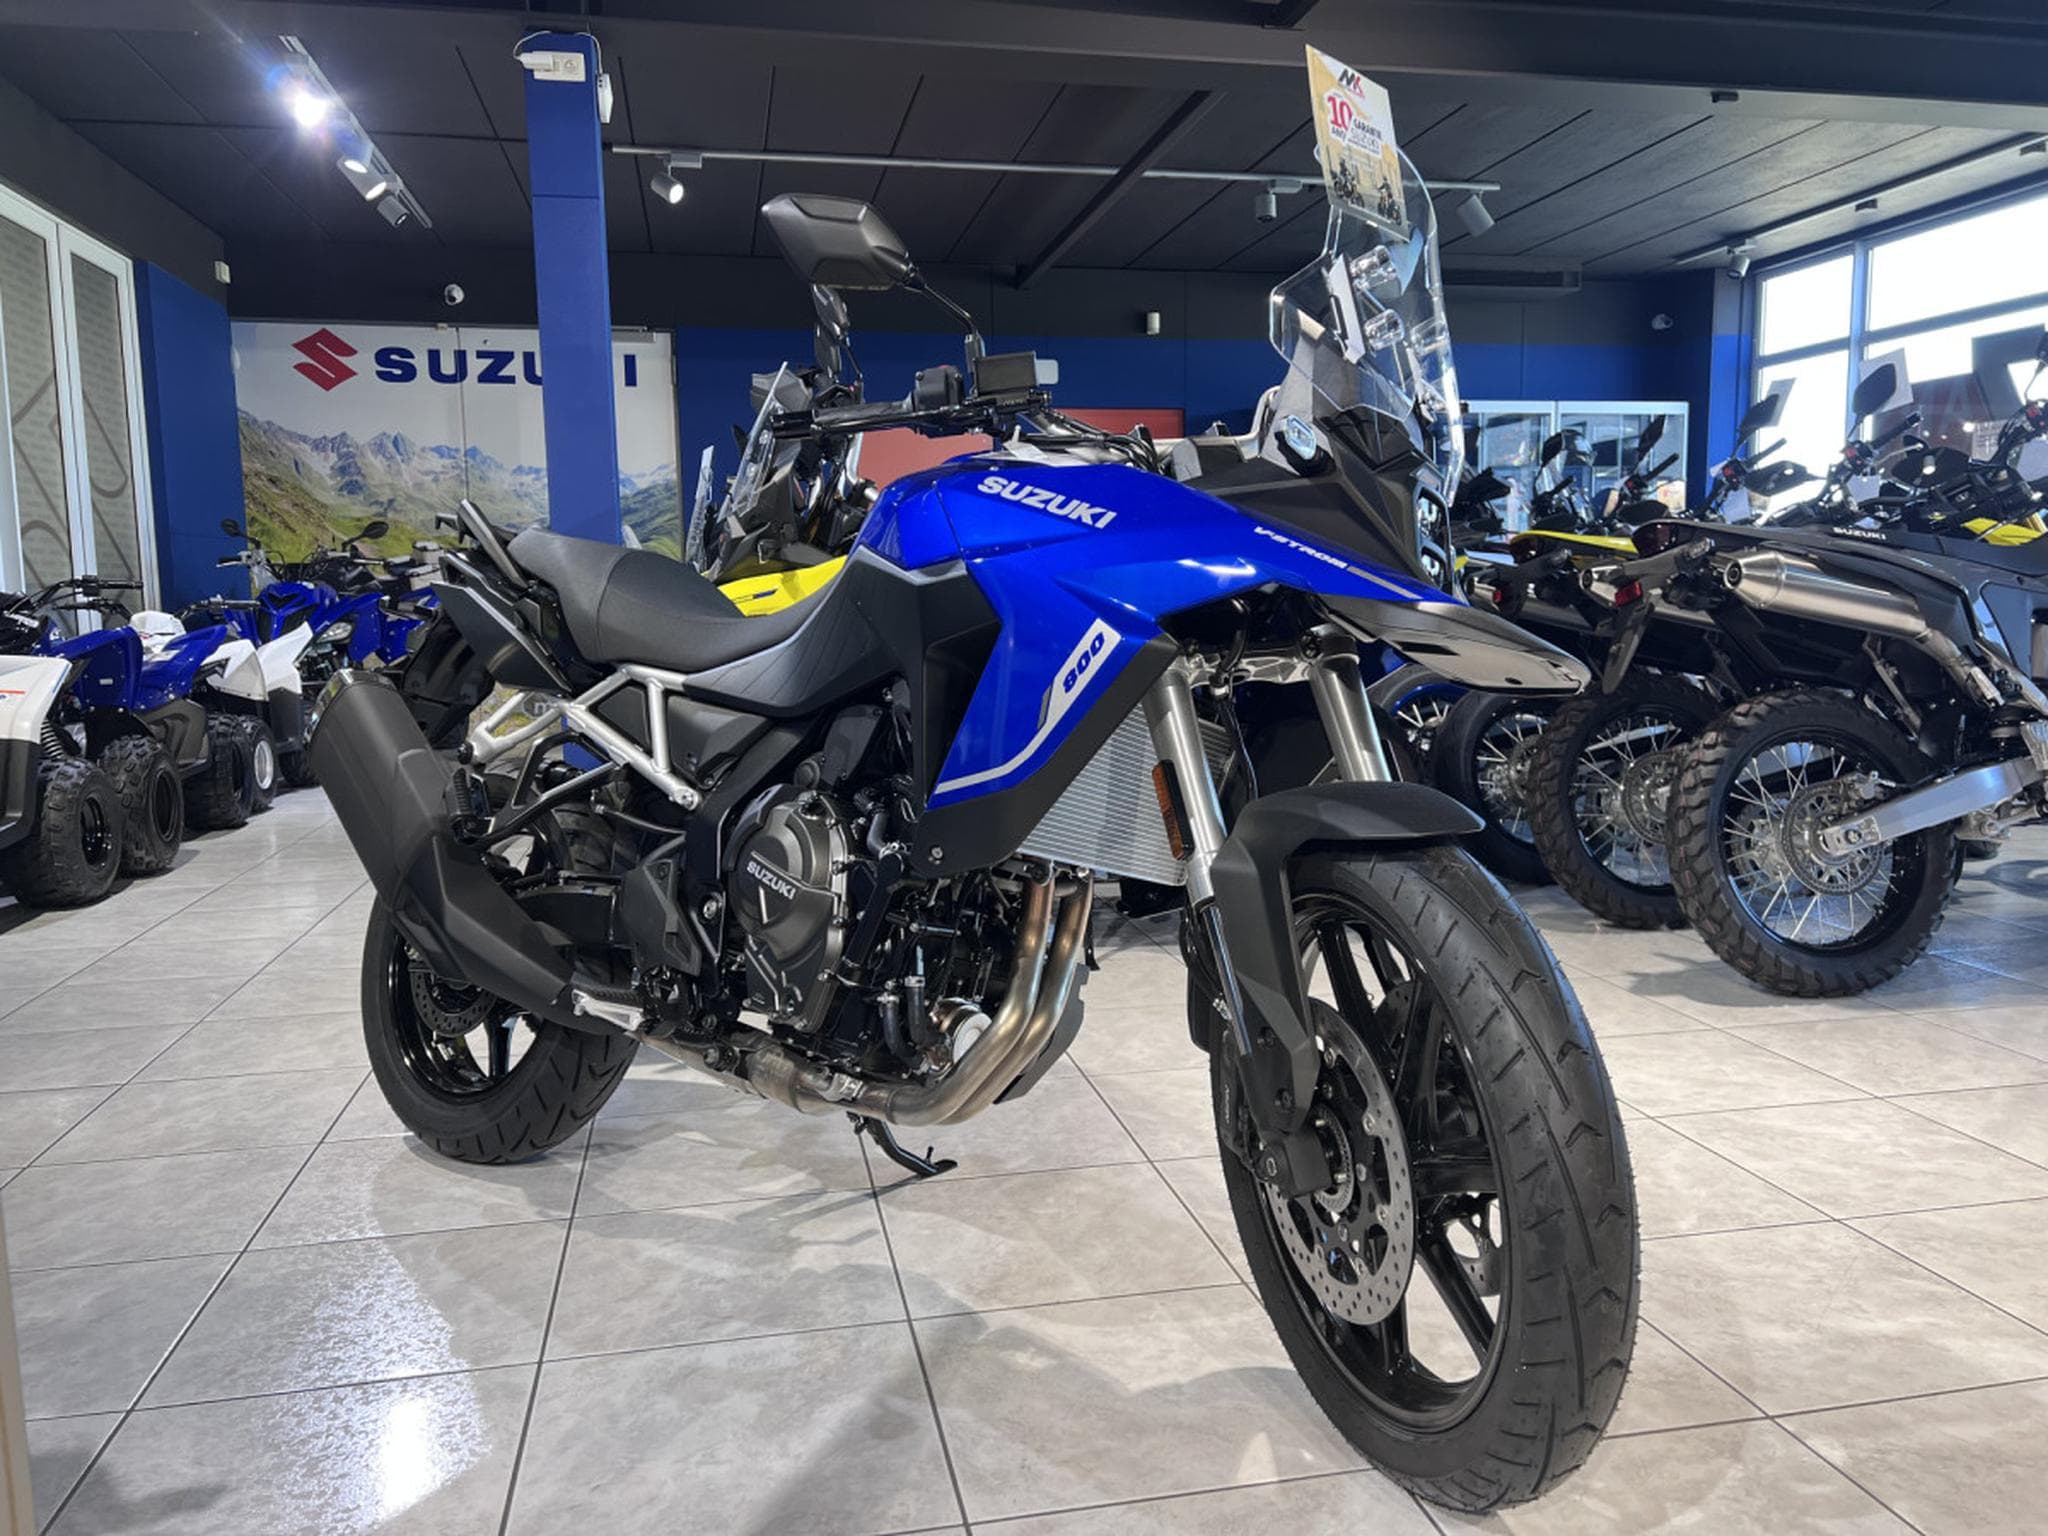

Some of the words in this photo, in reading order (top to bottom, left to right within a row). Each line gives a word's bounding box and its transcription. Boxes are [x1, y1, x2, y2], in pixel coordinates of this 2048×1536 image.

[1327, 95, 1353, 131] 10
[374, 347, 637, 386] SUZI
[977, 476, 1117, 529] SUZUKI
[1832, 526, 1886, 540] SUZUKI
[1063, 631, 1104, 694] 800
[747, 860, 796, 900] SUZUKI
